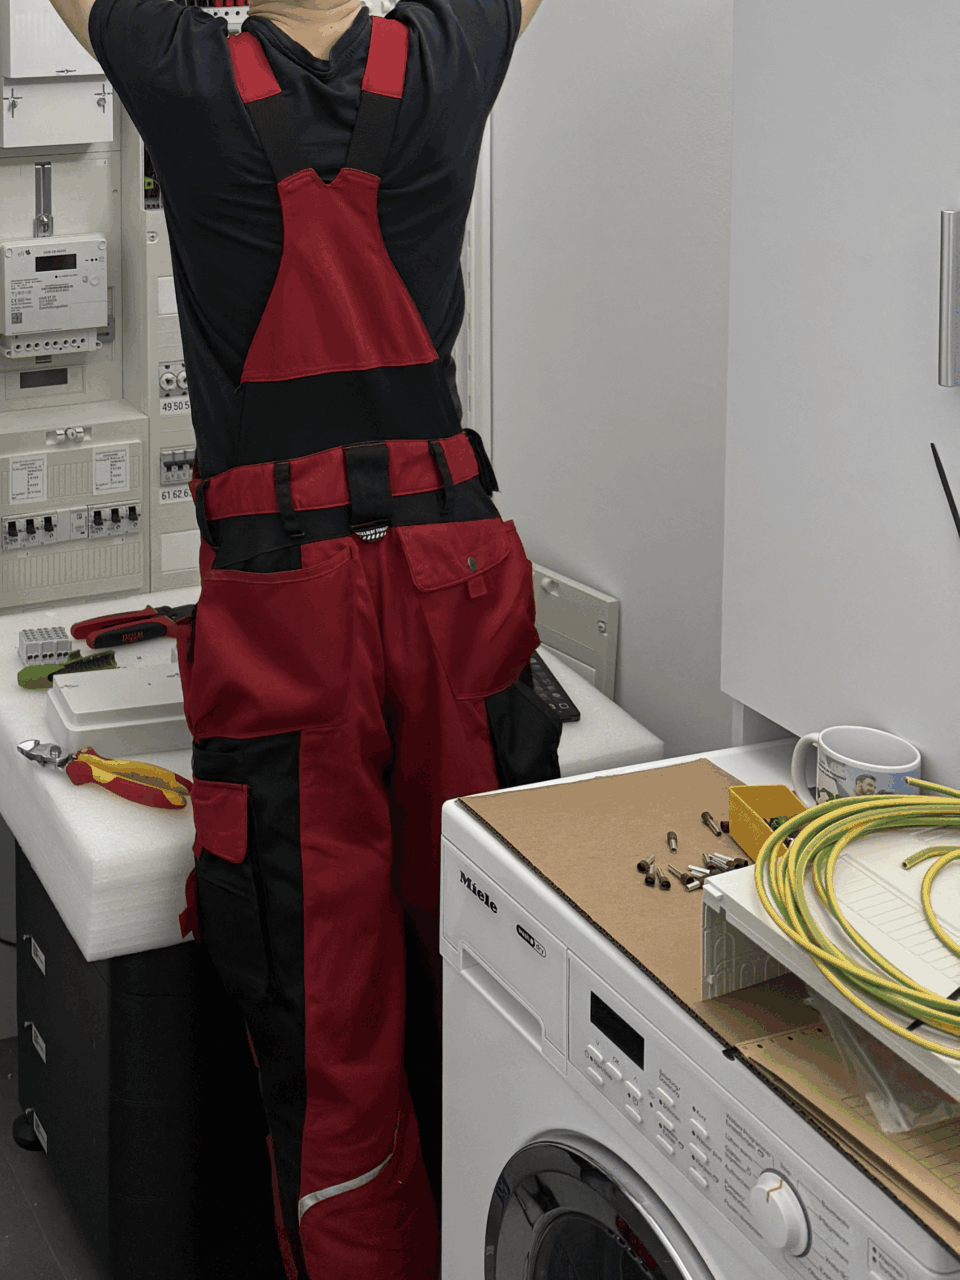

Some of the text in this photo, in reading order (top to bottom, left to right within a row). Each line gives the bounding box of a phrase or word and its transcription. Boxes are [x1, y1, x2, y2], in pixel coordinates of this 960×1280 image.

[162, 400, 190, 412] 49 50 5
[161, 490, 171, 500] 61
[172, 489, 182, 499] 62
[459, 869, 498, 914] Miele
